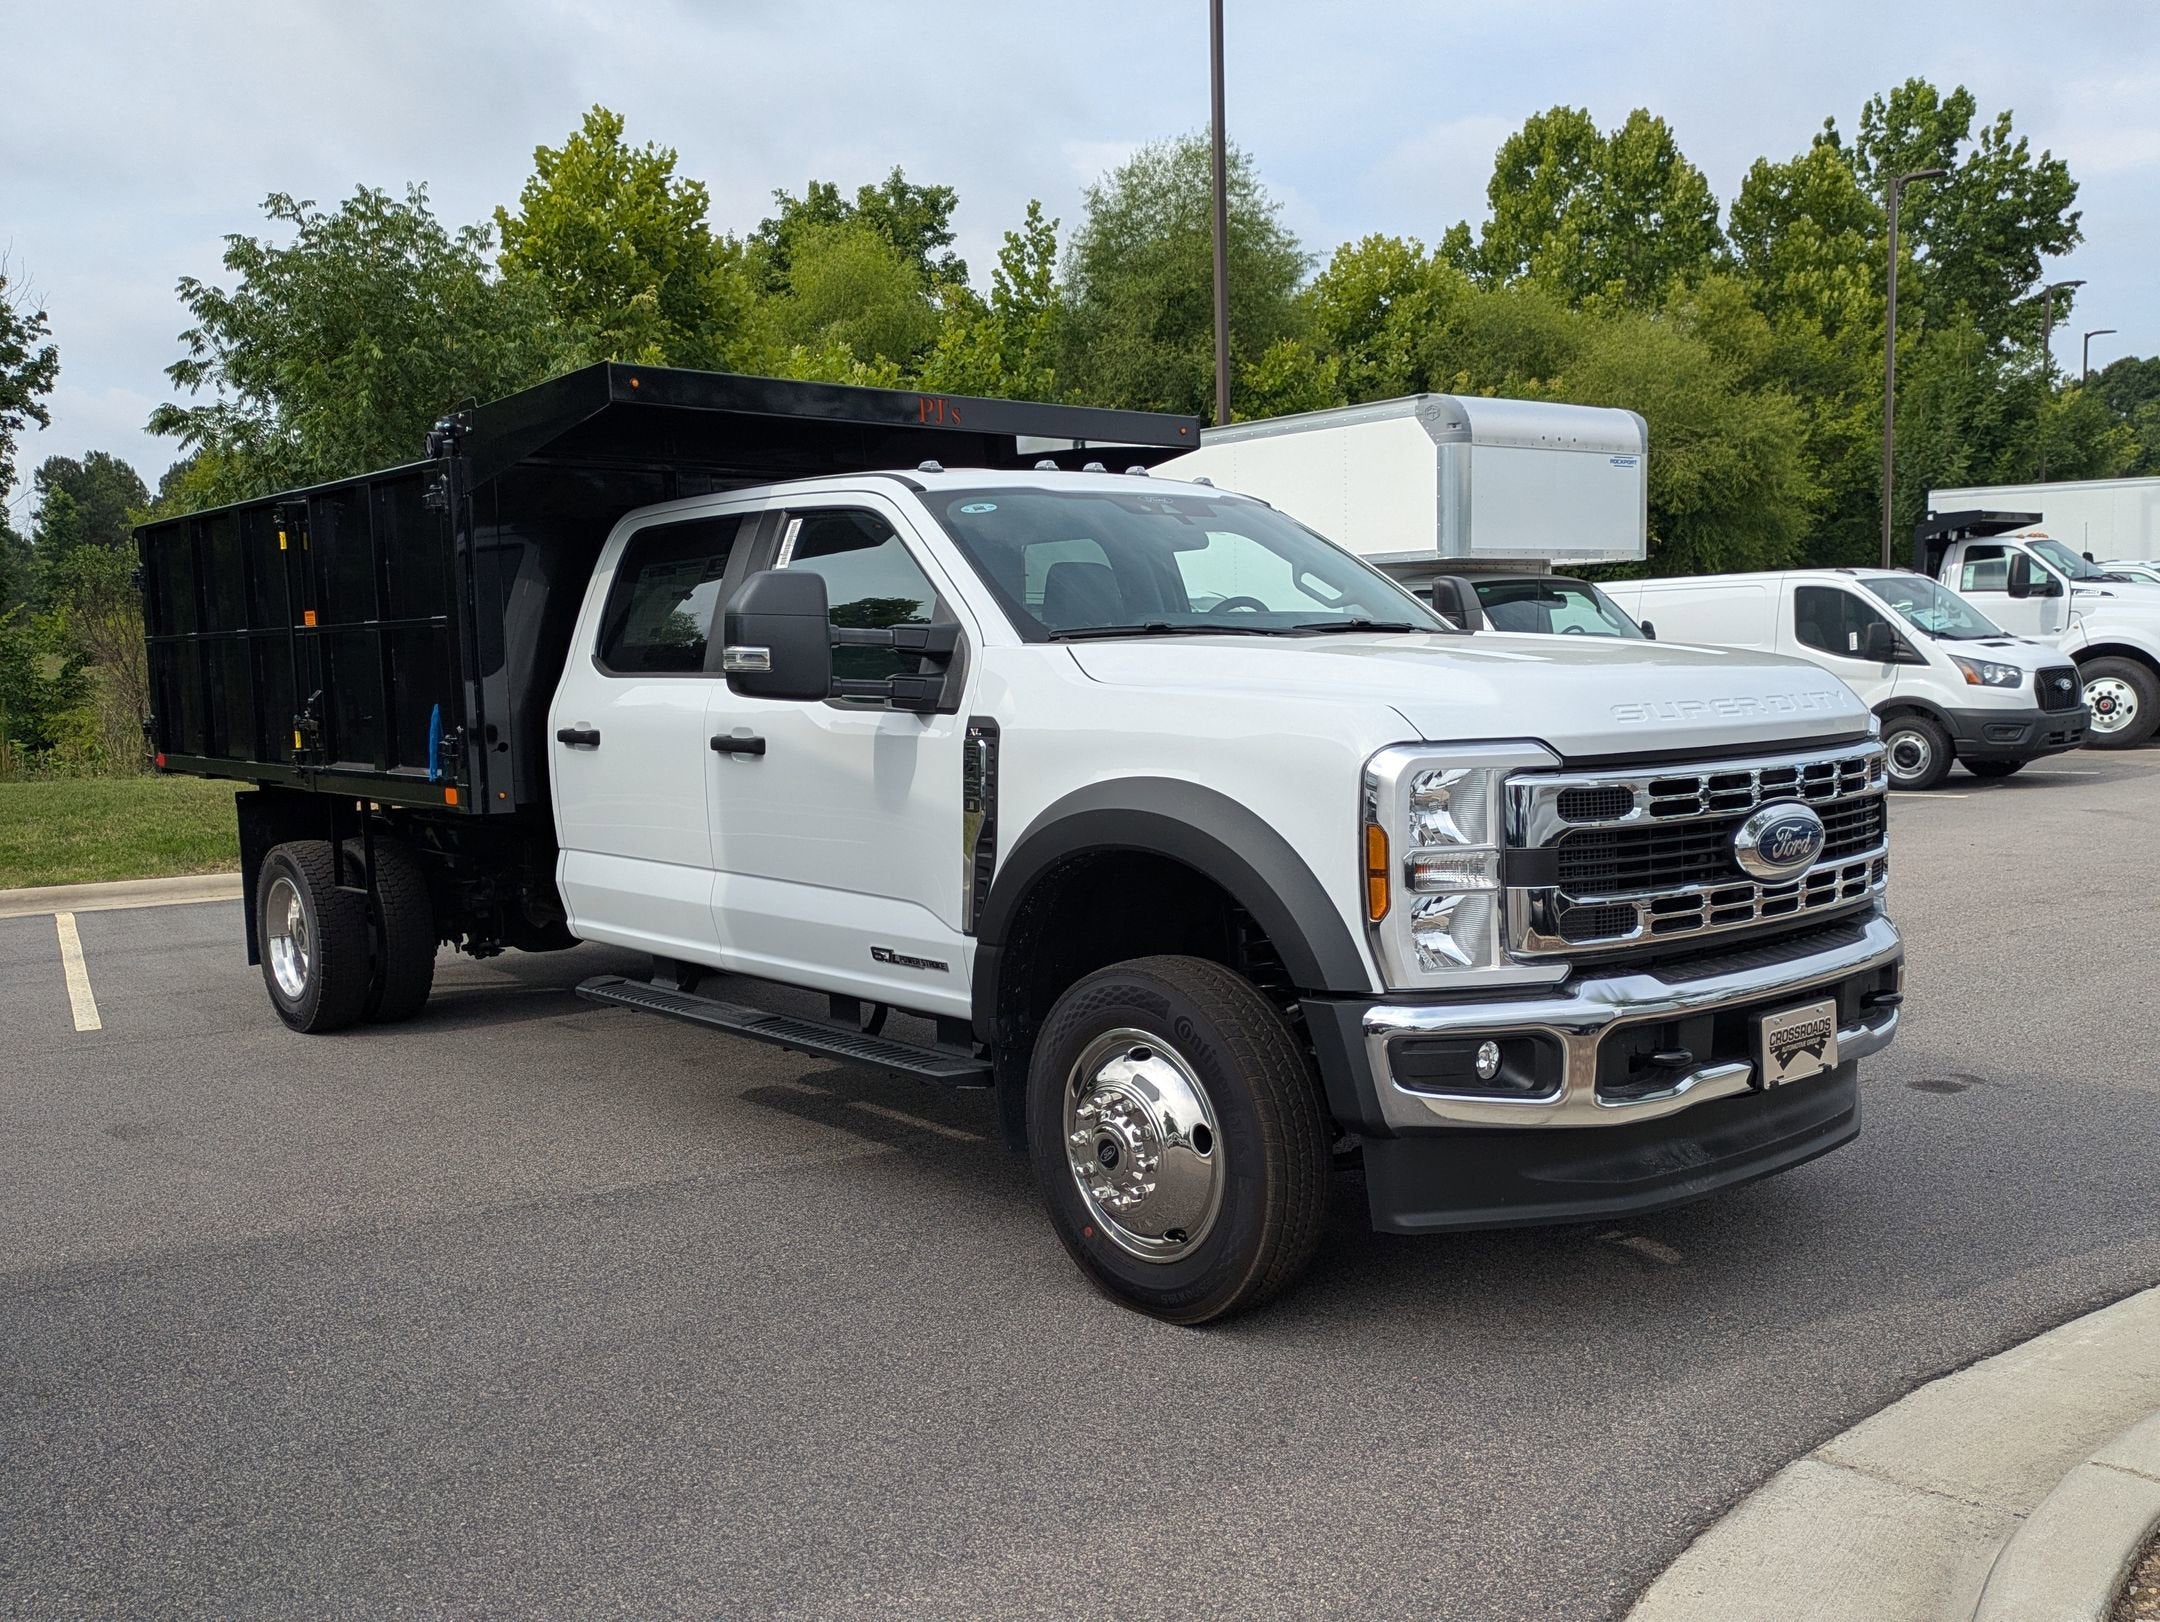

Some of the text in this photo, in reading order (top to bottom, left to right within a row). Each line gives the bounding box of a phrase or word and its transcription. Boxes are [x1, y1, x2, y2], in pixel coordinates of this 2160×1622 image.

[1610, 690, 1848, 724] SUPER DUTY
[969, 727, 982, 736] XL
[1772, 825, 1812, 859] Ford
[1769, 1017, 1831, 1046] CROSSROADS
